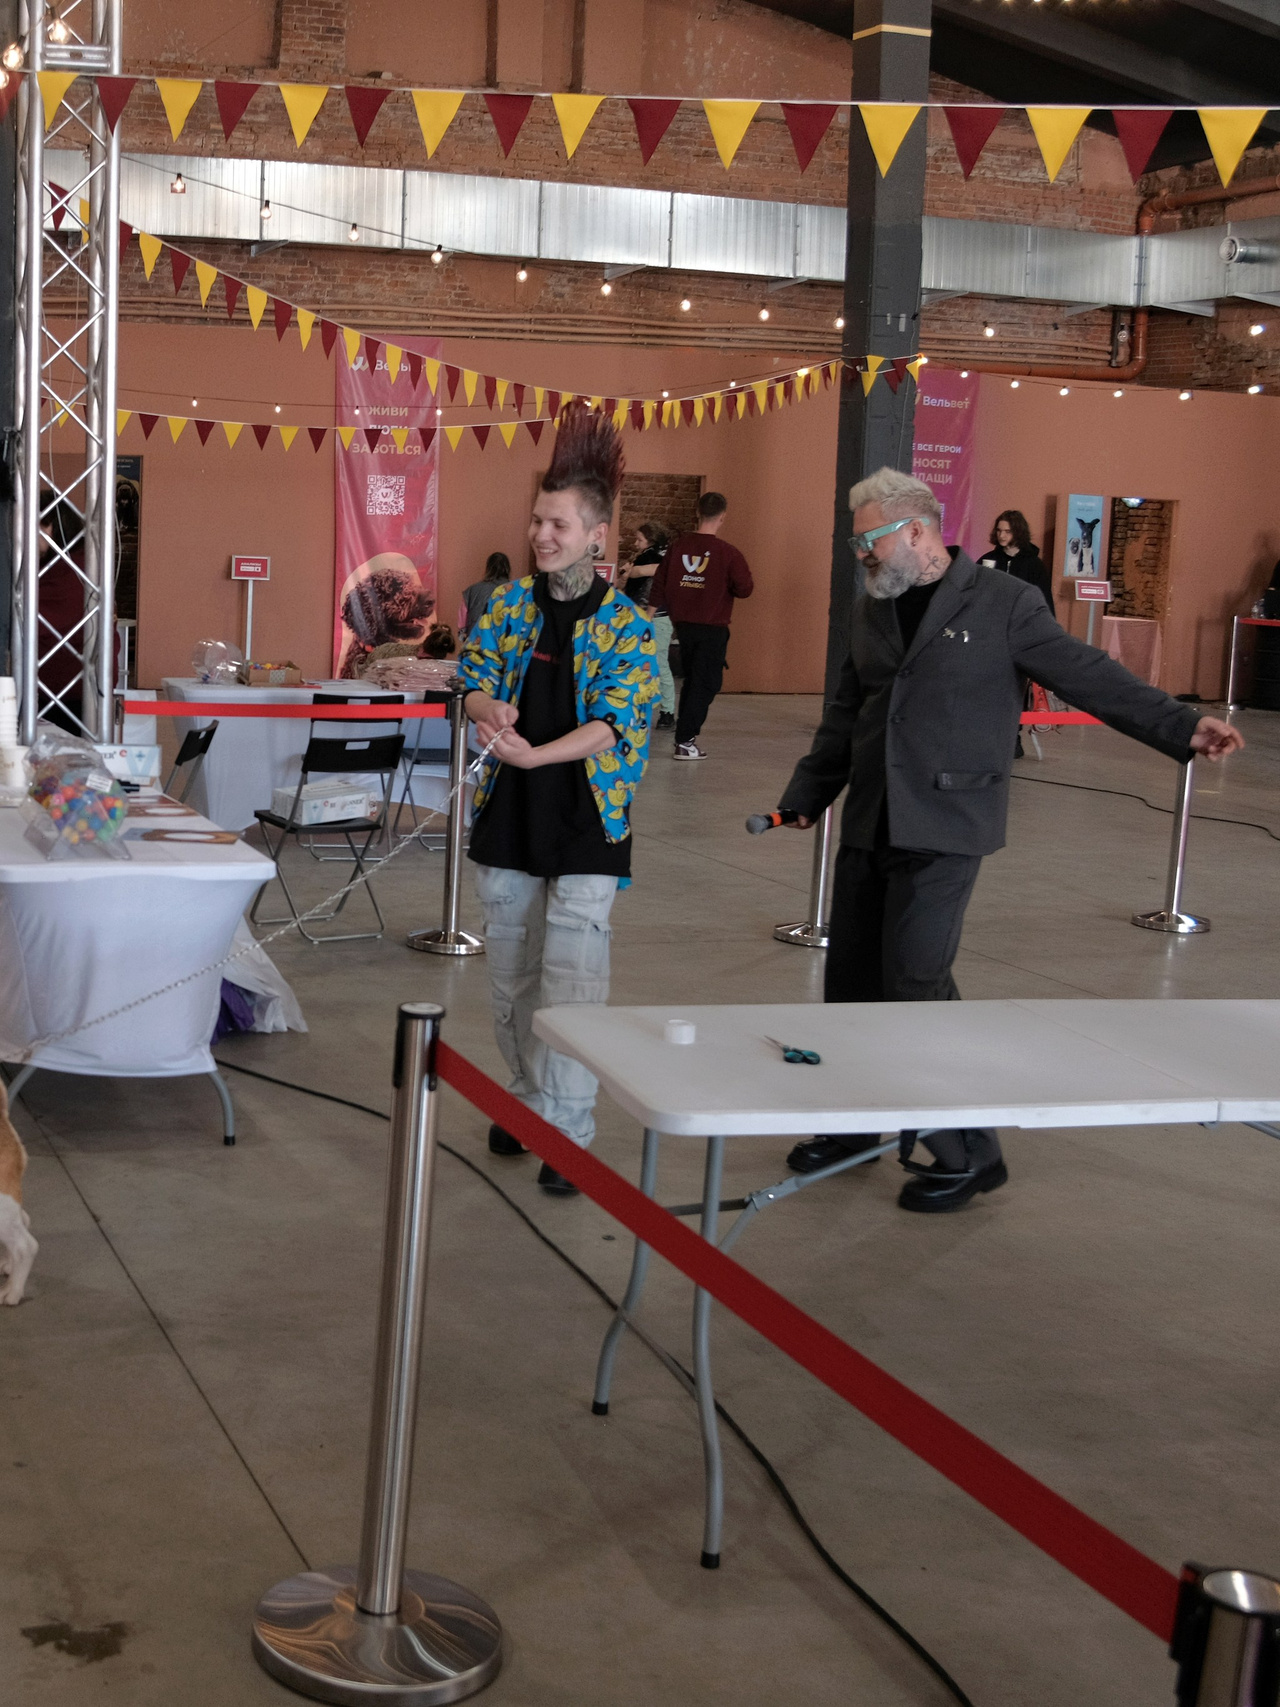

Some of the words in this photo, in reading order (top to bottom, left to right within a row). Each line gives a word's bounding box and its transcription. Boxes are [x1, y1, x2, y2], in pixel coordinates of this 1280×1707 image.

[923, 396, 970, 409] Вельвет
[369, 406, 408, 416] ЖИВИ
[917, 443, 933, 452] ВСЕ
[934, 444, 962, 454] ГЕРОИ
[913, 457, 951, 469] НОСЯТ
